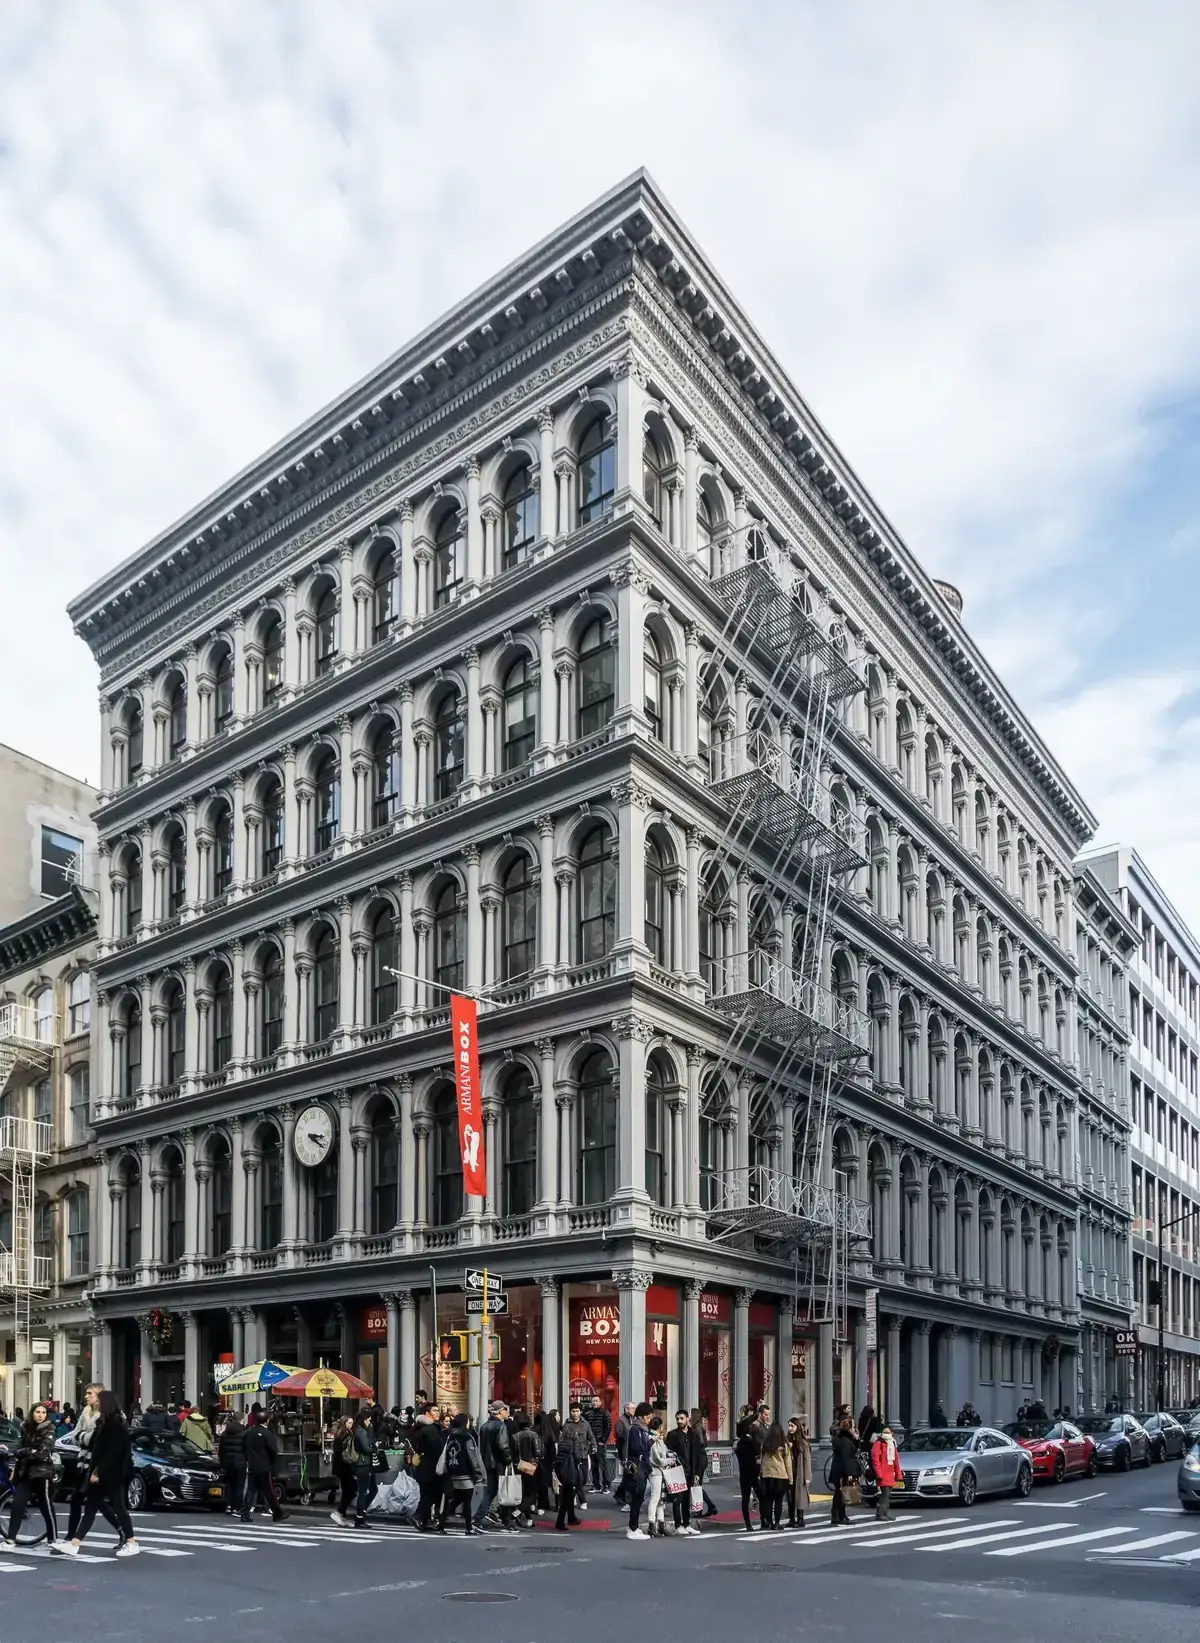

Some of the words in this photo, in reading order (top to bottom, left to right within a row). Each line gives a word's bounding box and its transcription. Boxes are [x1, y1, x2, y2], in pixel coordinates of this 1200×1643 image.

[459, 1020, 470, 1064] BOX
[472, 1275, 482, 1284] ONE
[580, 1305, 620, 1320] ARMAN
[701, 1302, 718, 1314] BOX
[367, 1318, 388, 1328] BOX
[579, 1319, 620, 1336] BOX
[1116, 1333, 1134, 1342] OK
[791, 1355, 806, 1366] BO
[221, 1382, 256, 1392] SABRETT
